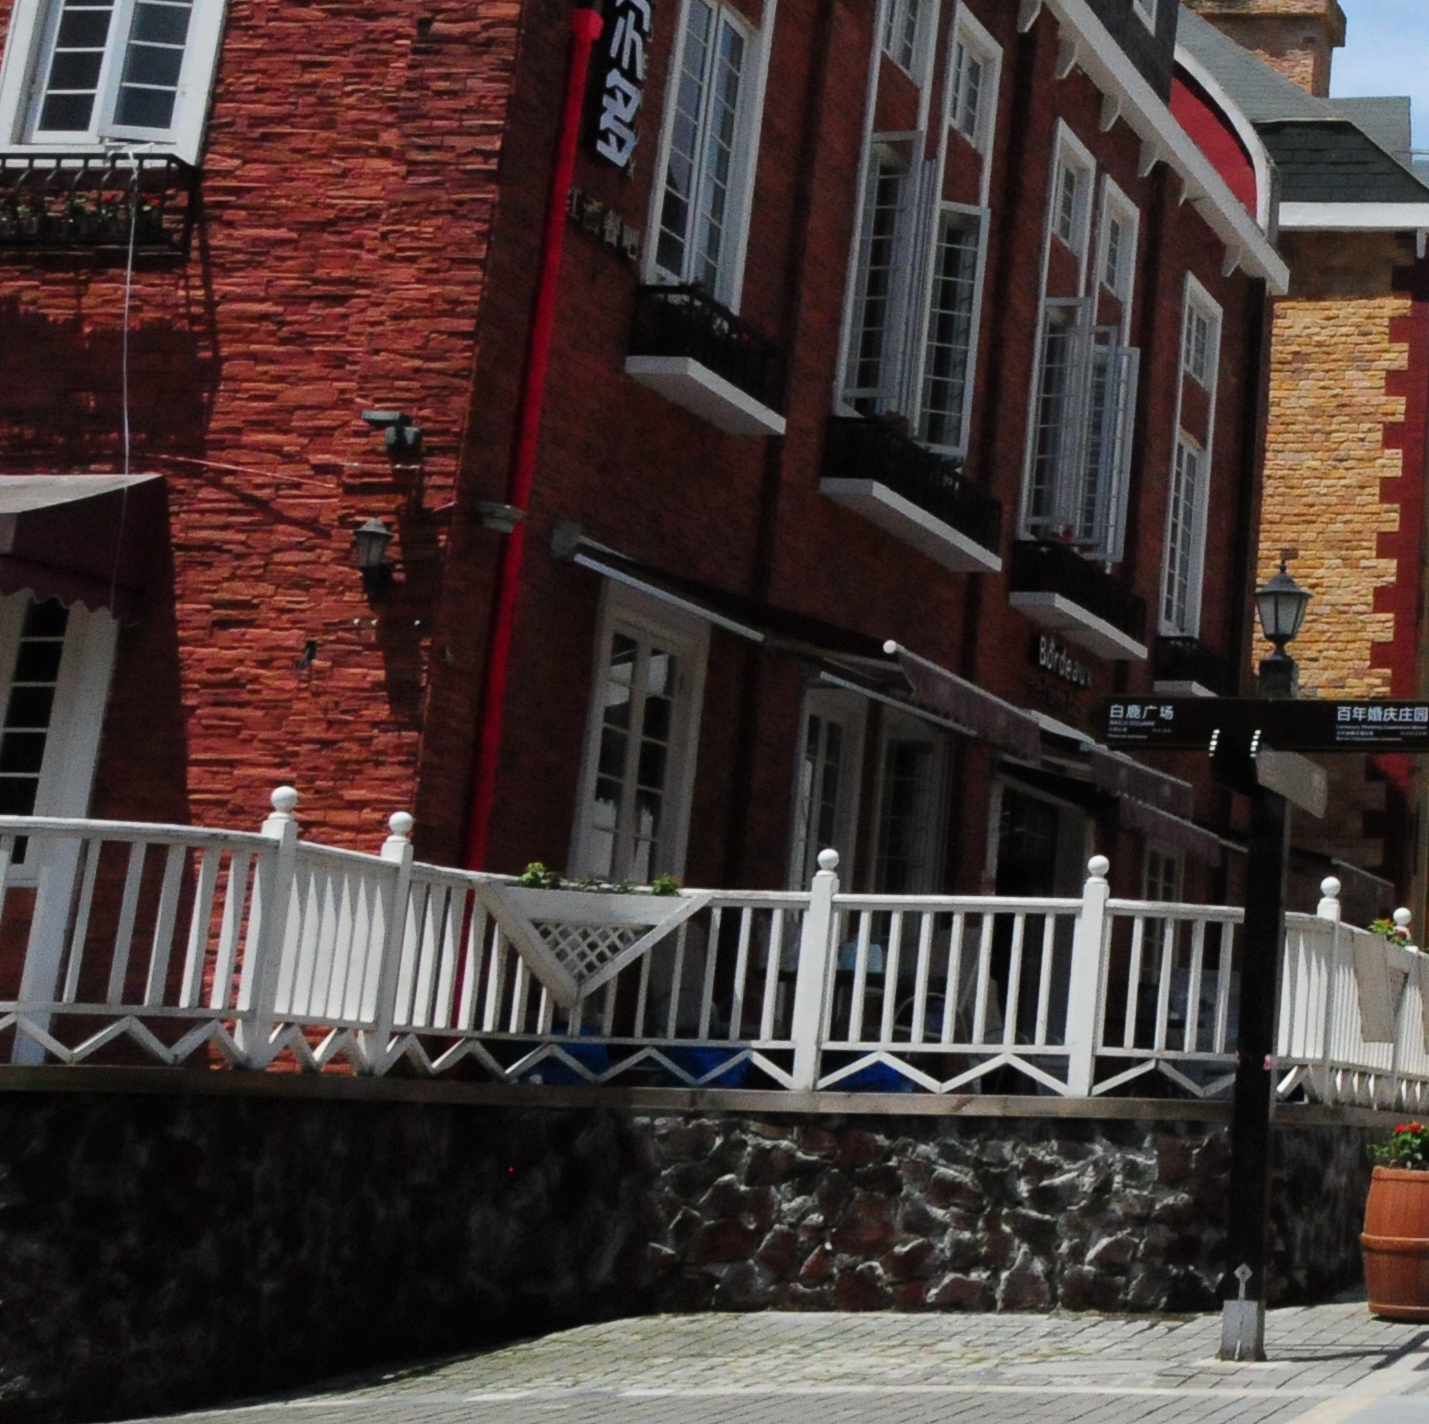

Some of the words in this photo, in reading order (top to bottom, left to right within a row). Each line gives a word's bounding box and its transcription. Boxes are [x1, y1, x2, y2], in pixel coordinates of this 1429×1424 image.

[1109, 704, 1175, 720] 白鹿广场
[1336, 706, 1429, 723] 百年婚庆庄园
